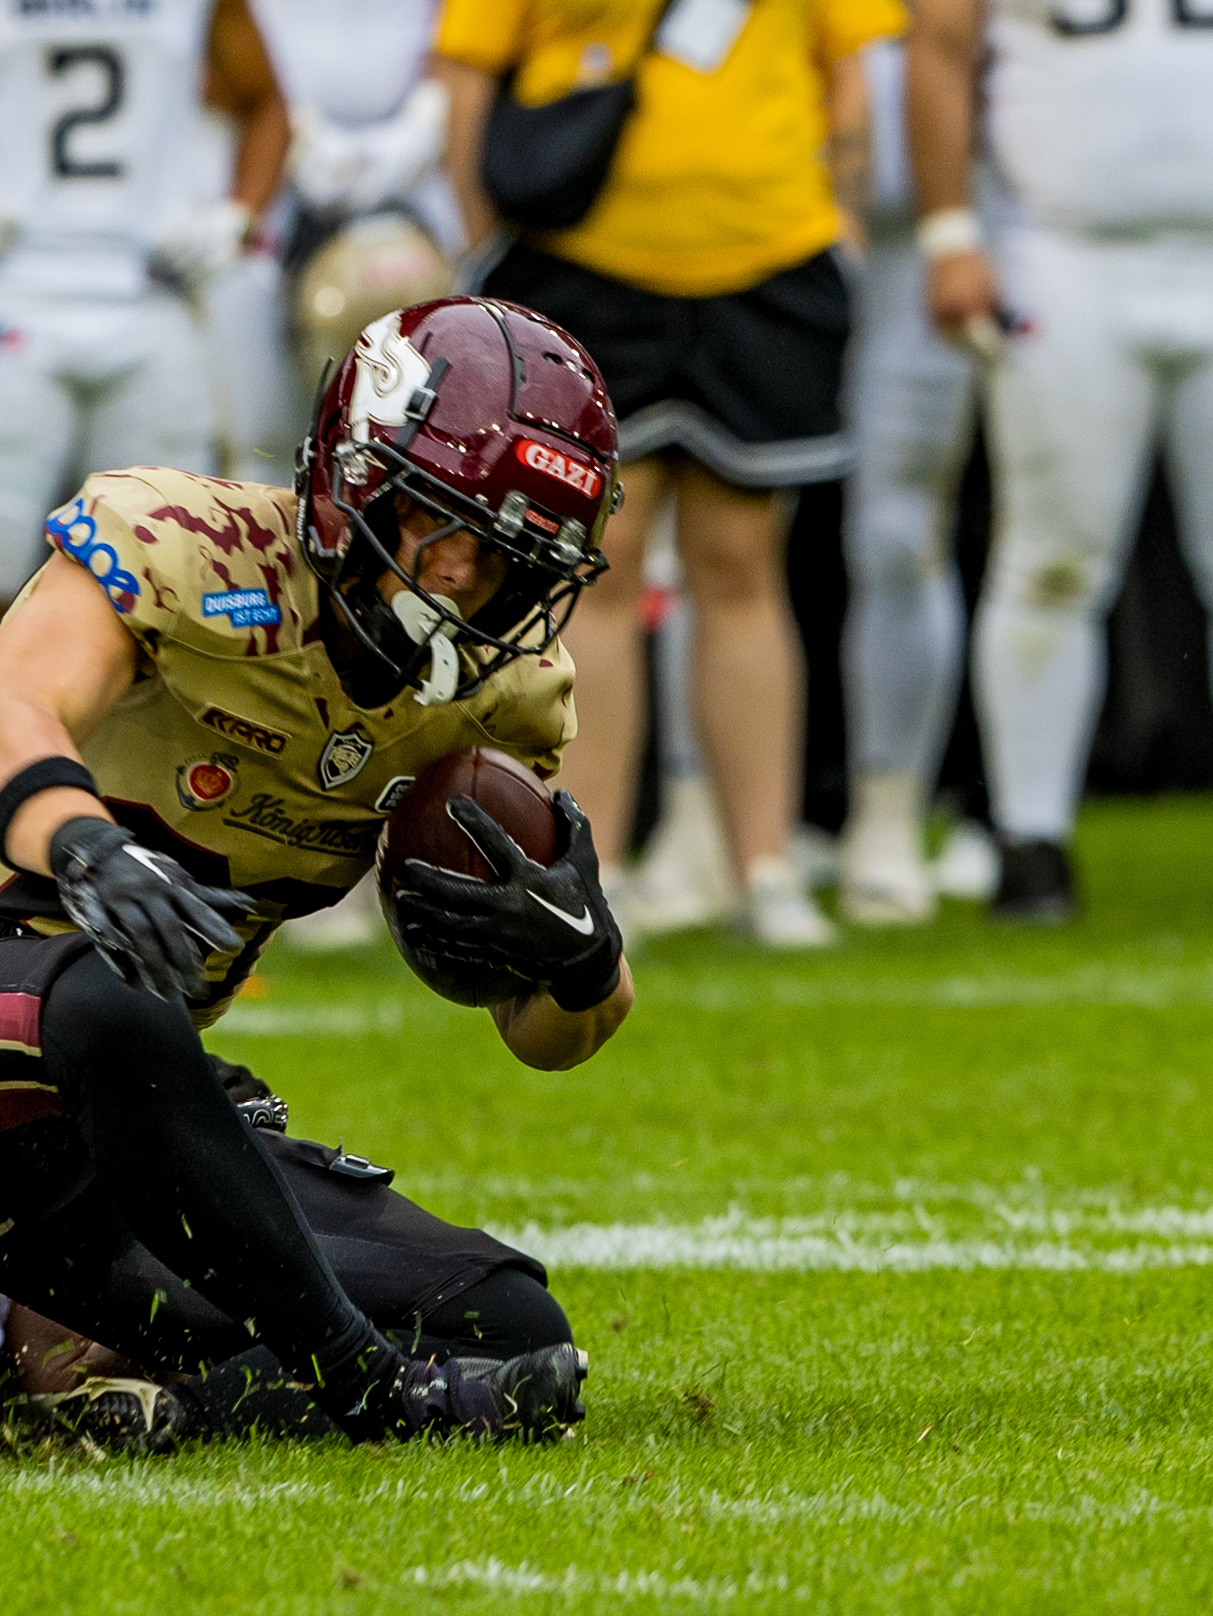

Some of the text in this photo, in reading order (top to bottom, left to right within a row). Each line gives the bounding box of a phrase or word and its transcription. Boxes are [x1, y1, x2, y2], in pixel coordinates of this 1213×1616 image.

[48, 44, 125, 178] 2
[524, 443, 599, 497] GAZI
[205, 591, 269, 613] DUISBURG
[230, 793, 314, 846] König
